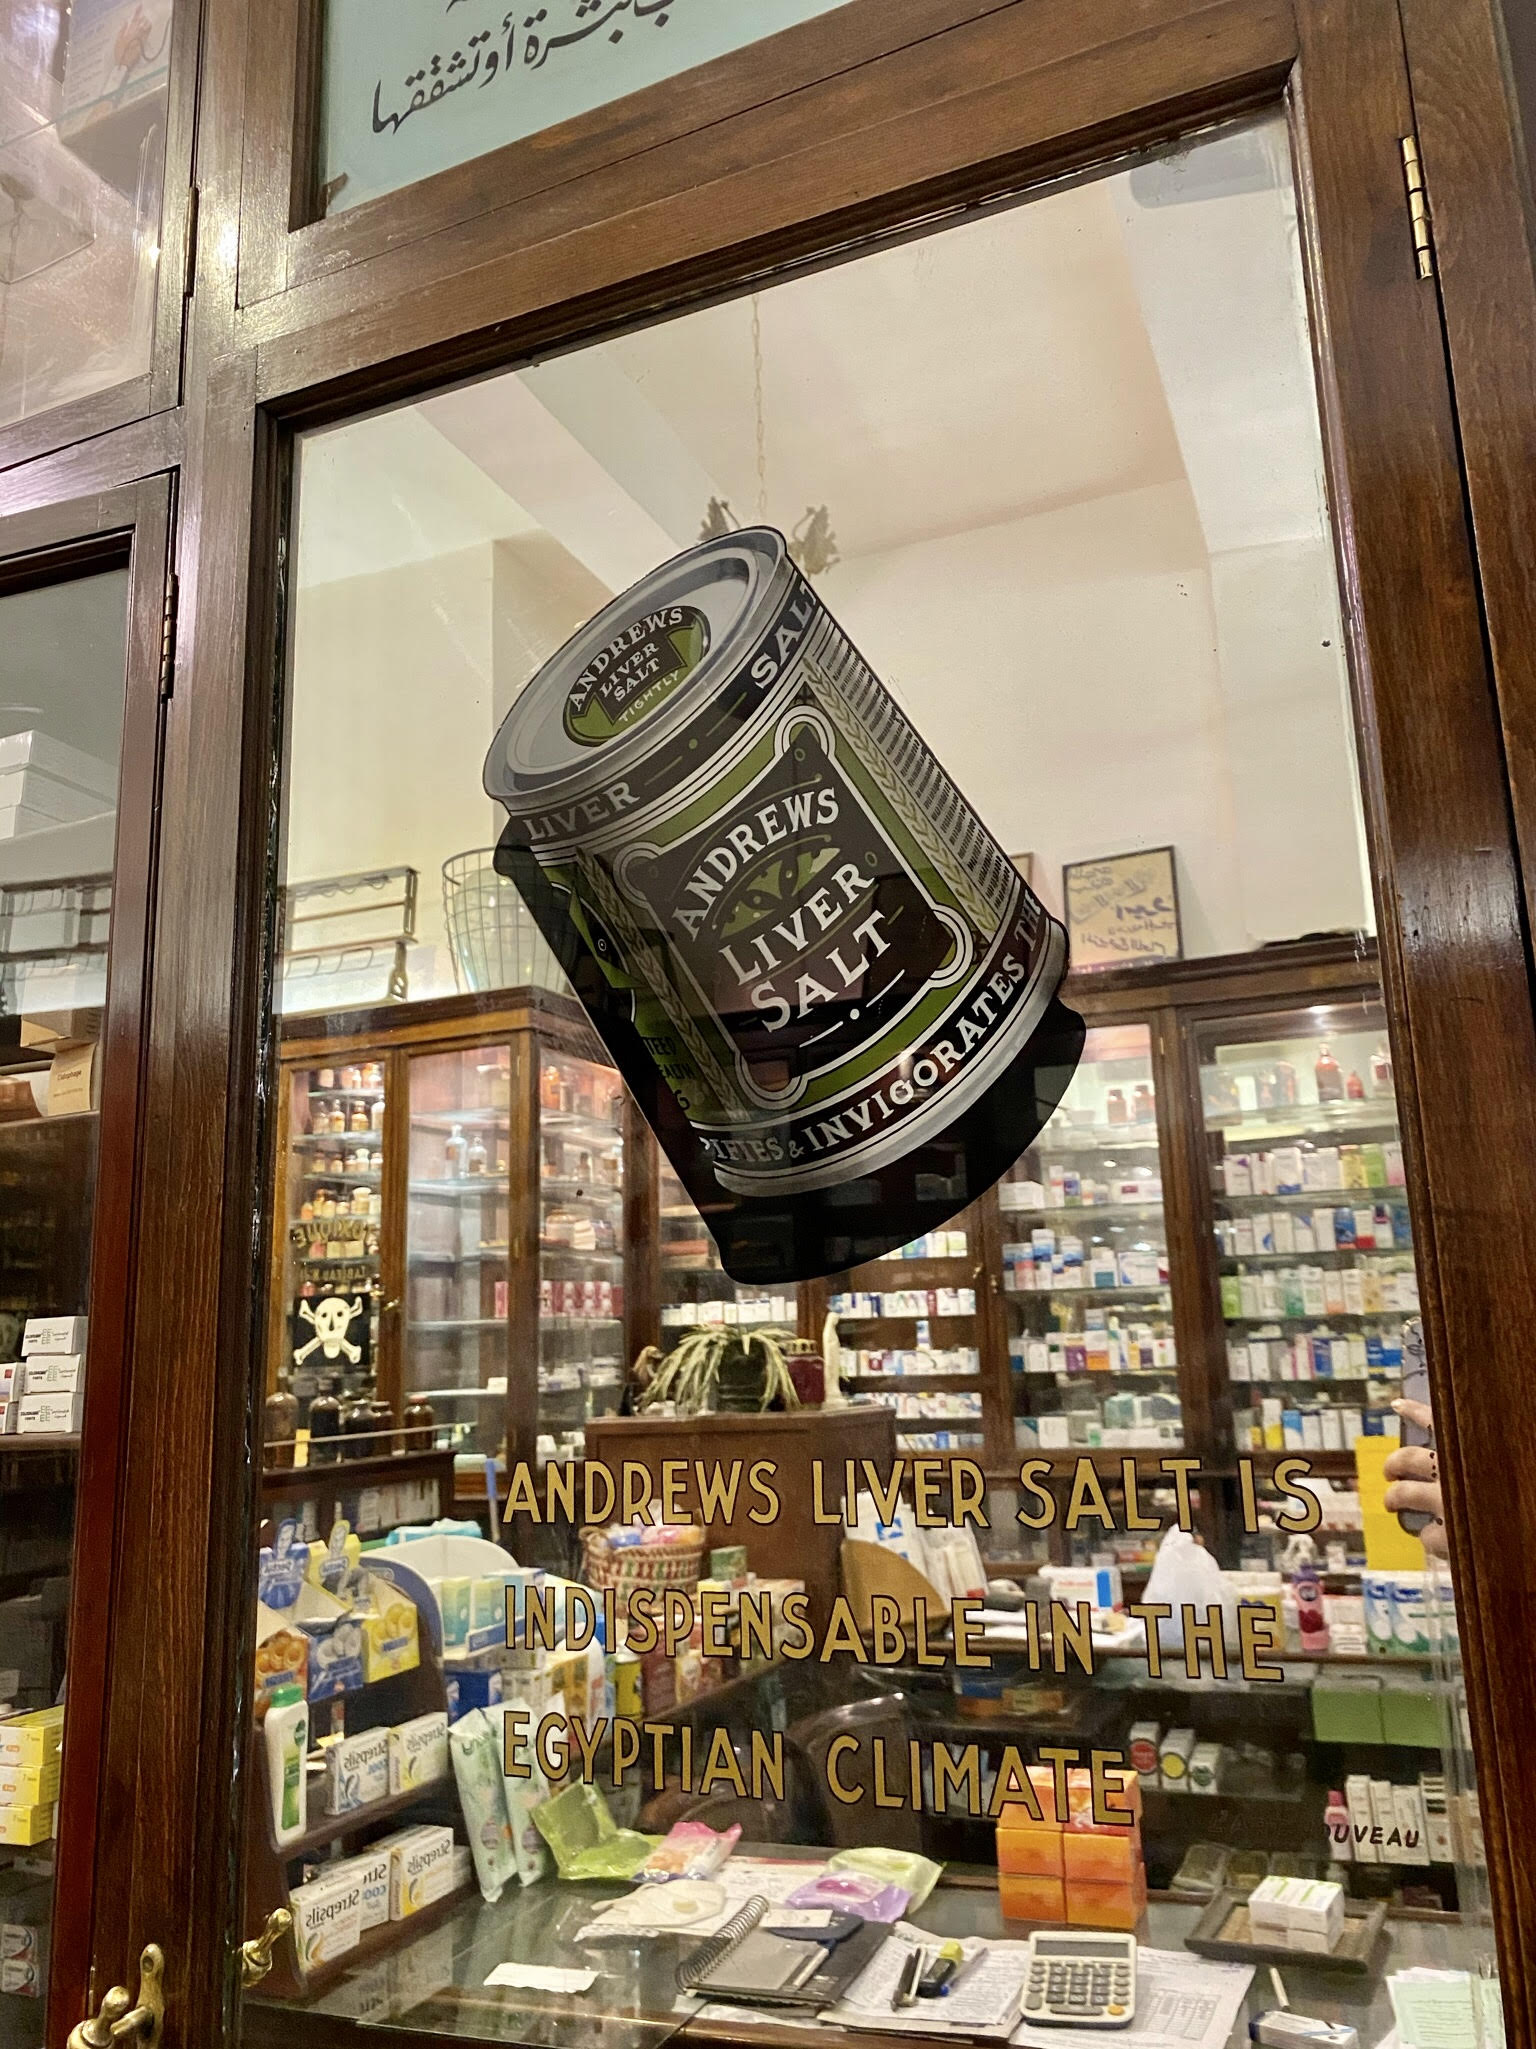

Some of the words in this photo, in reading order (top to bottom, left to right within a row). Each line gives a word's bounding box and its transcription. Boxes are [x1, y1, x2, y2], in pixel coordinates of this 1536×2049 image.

[569, 607, 683, 712] ANDREWS
[600, 642, 660, 698] LIVER
[613, 657, 660, 702] SALT
[619, 669, 679, 722] TIGHTLY
[522, 779, 640, 841] LIVER
[671, 786, 840, 942] ANDREWS
[718, 863, 876, 986] LIVER
[750, 909, 892, 1034] SALT
[788, 1140, 805, 1159] &
[801, 952, 1025, 1151] INVIGORATES
[501, 1458, 782, 1527] ANDREWS
[810, 1457, 991, 1529] LIVER
[1016, 1456, 1202, 1533] SALT
[1237, 1456, 1324, 1534] IS
[503, 1583, 993, 1670] INDISPENSABLE
[1024, 1599, 1095, 1677] IN
[1129, 1602, 1285, 1683] THE
[502, 1710, 787, 1802] EGYPTIAN
[825, 1734, 1136, 1828] CLIMATE
